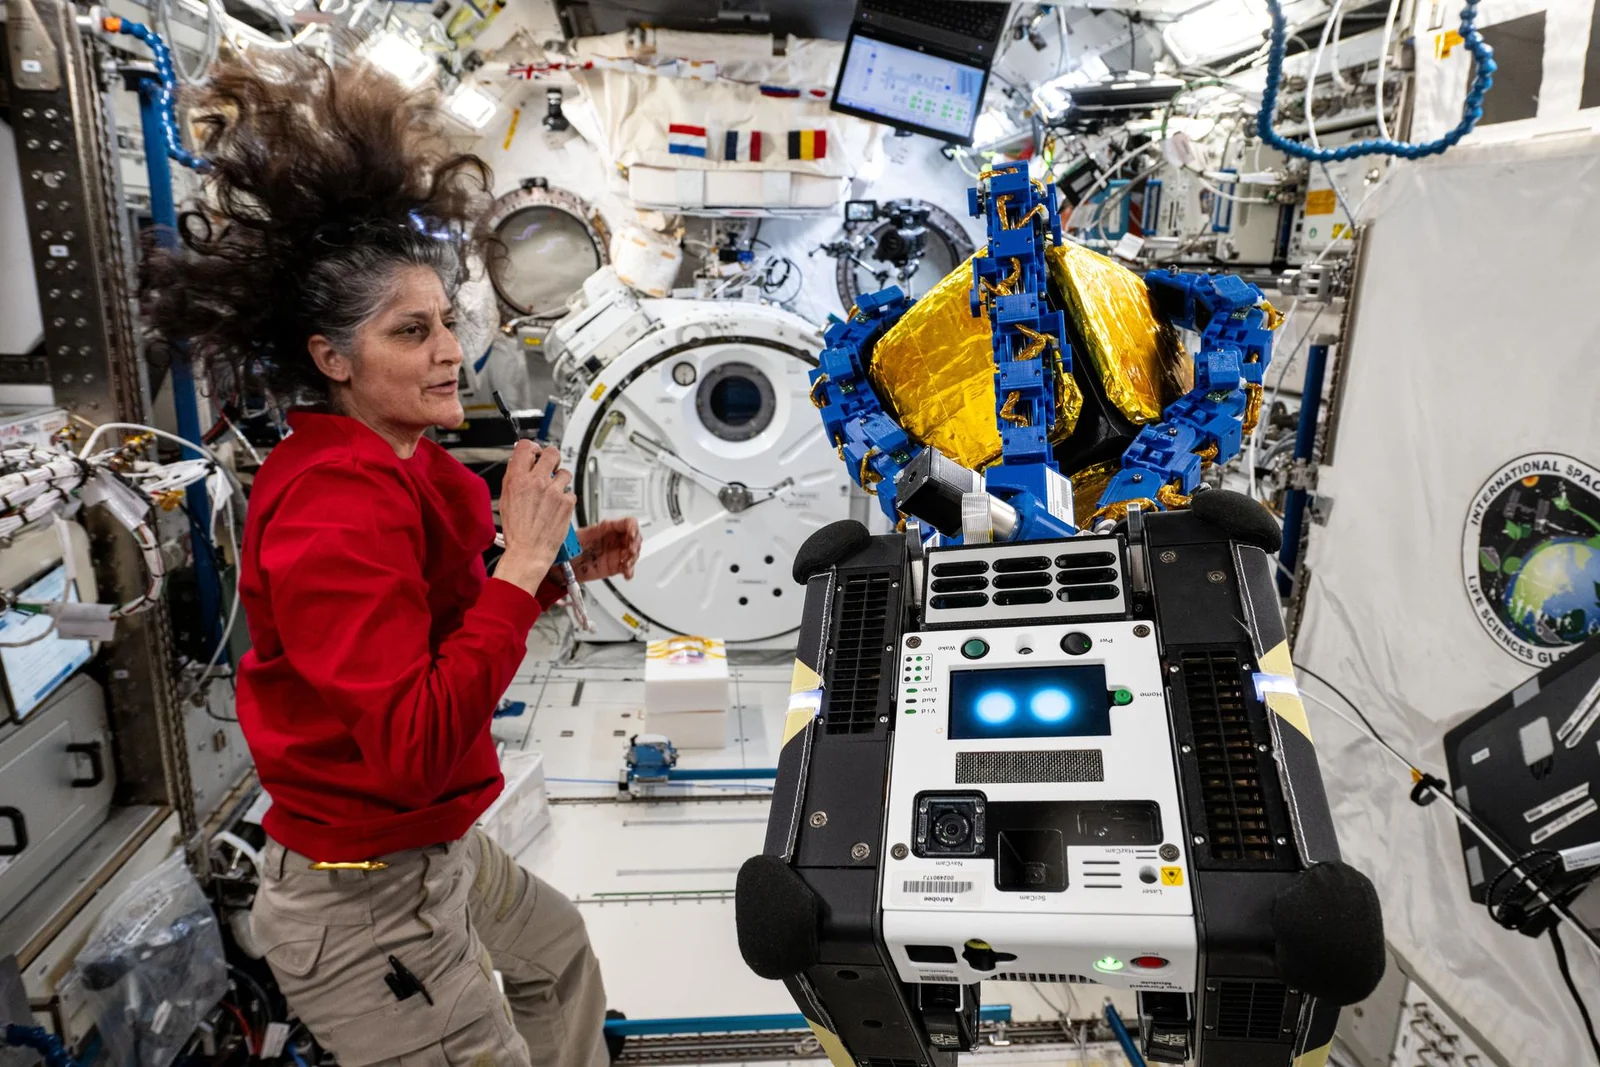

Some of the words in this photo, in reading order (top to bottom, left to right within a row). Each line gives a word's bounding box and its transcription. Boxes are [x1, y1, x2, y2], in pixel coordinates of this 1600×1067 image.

[1471, 459, 1560, 526] INTERNATIONAL
[1468, 575, 1485, 606] LIFE
[1481, 608, 1534, 660] SCIENCES
